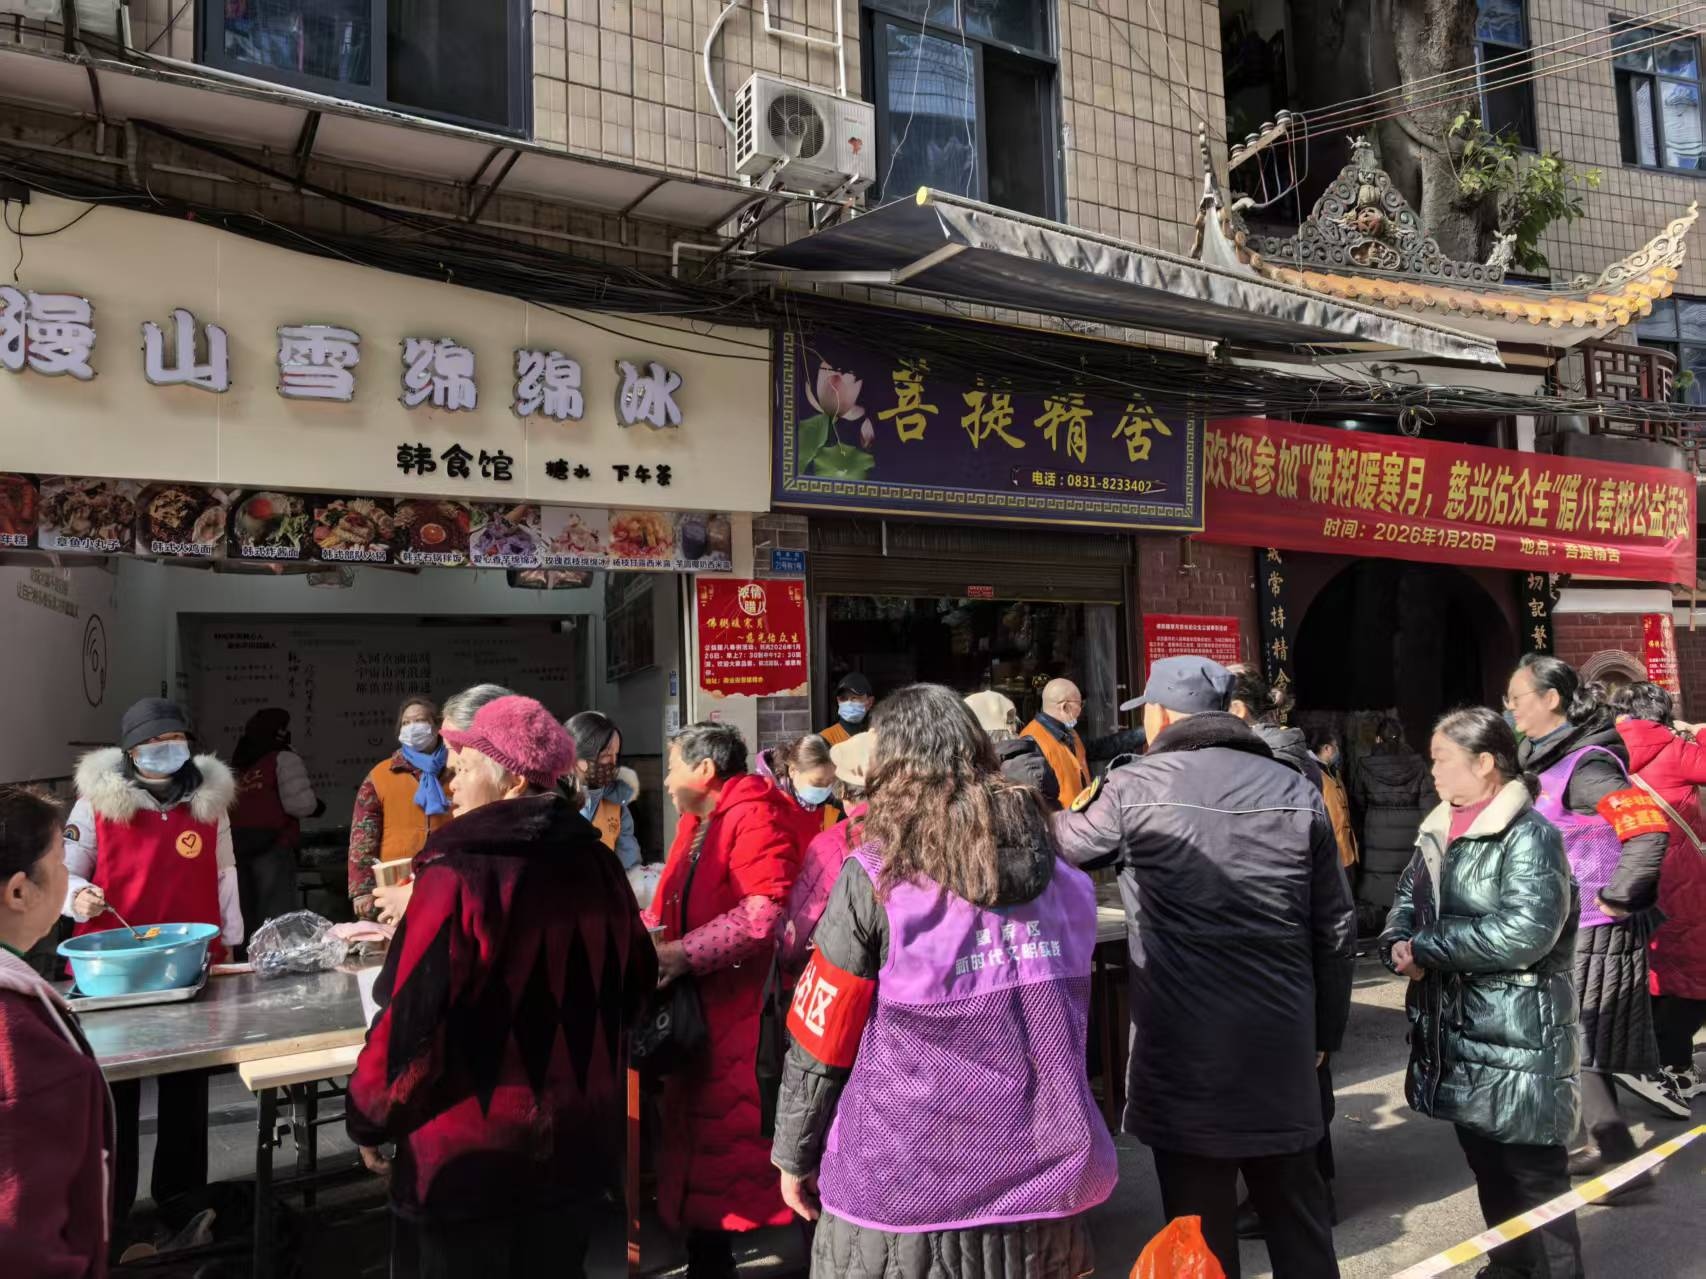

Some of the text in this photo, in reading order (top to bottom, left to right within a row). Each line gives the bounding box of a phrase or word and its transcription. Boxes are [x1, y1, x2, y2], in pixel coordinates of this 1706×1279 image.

[877, 358, 1172, 464] 菩提精舍
[397, 443, 672, 486] 韩食馆 糖水 下午茶
[57, 536, 120, 549] 章鱼小丸子
[1323, 518, 1621, 563] 时间：2026年1月26日 地点：菩提精舍
[152, 541, 212, 556] 韩式火鸡面
[242, 546, 299, 558] 韩式炸酱面
[322, 550, 386, 562] 韩式部队火锅
[403, 552, 463, 563] 韩式石锅拌饭
